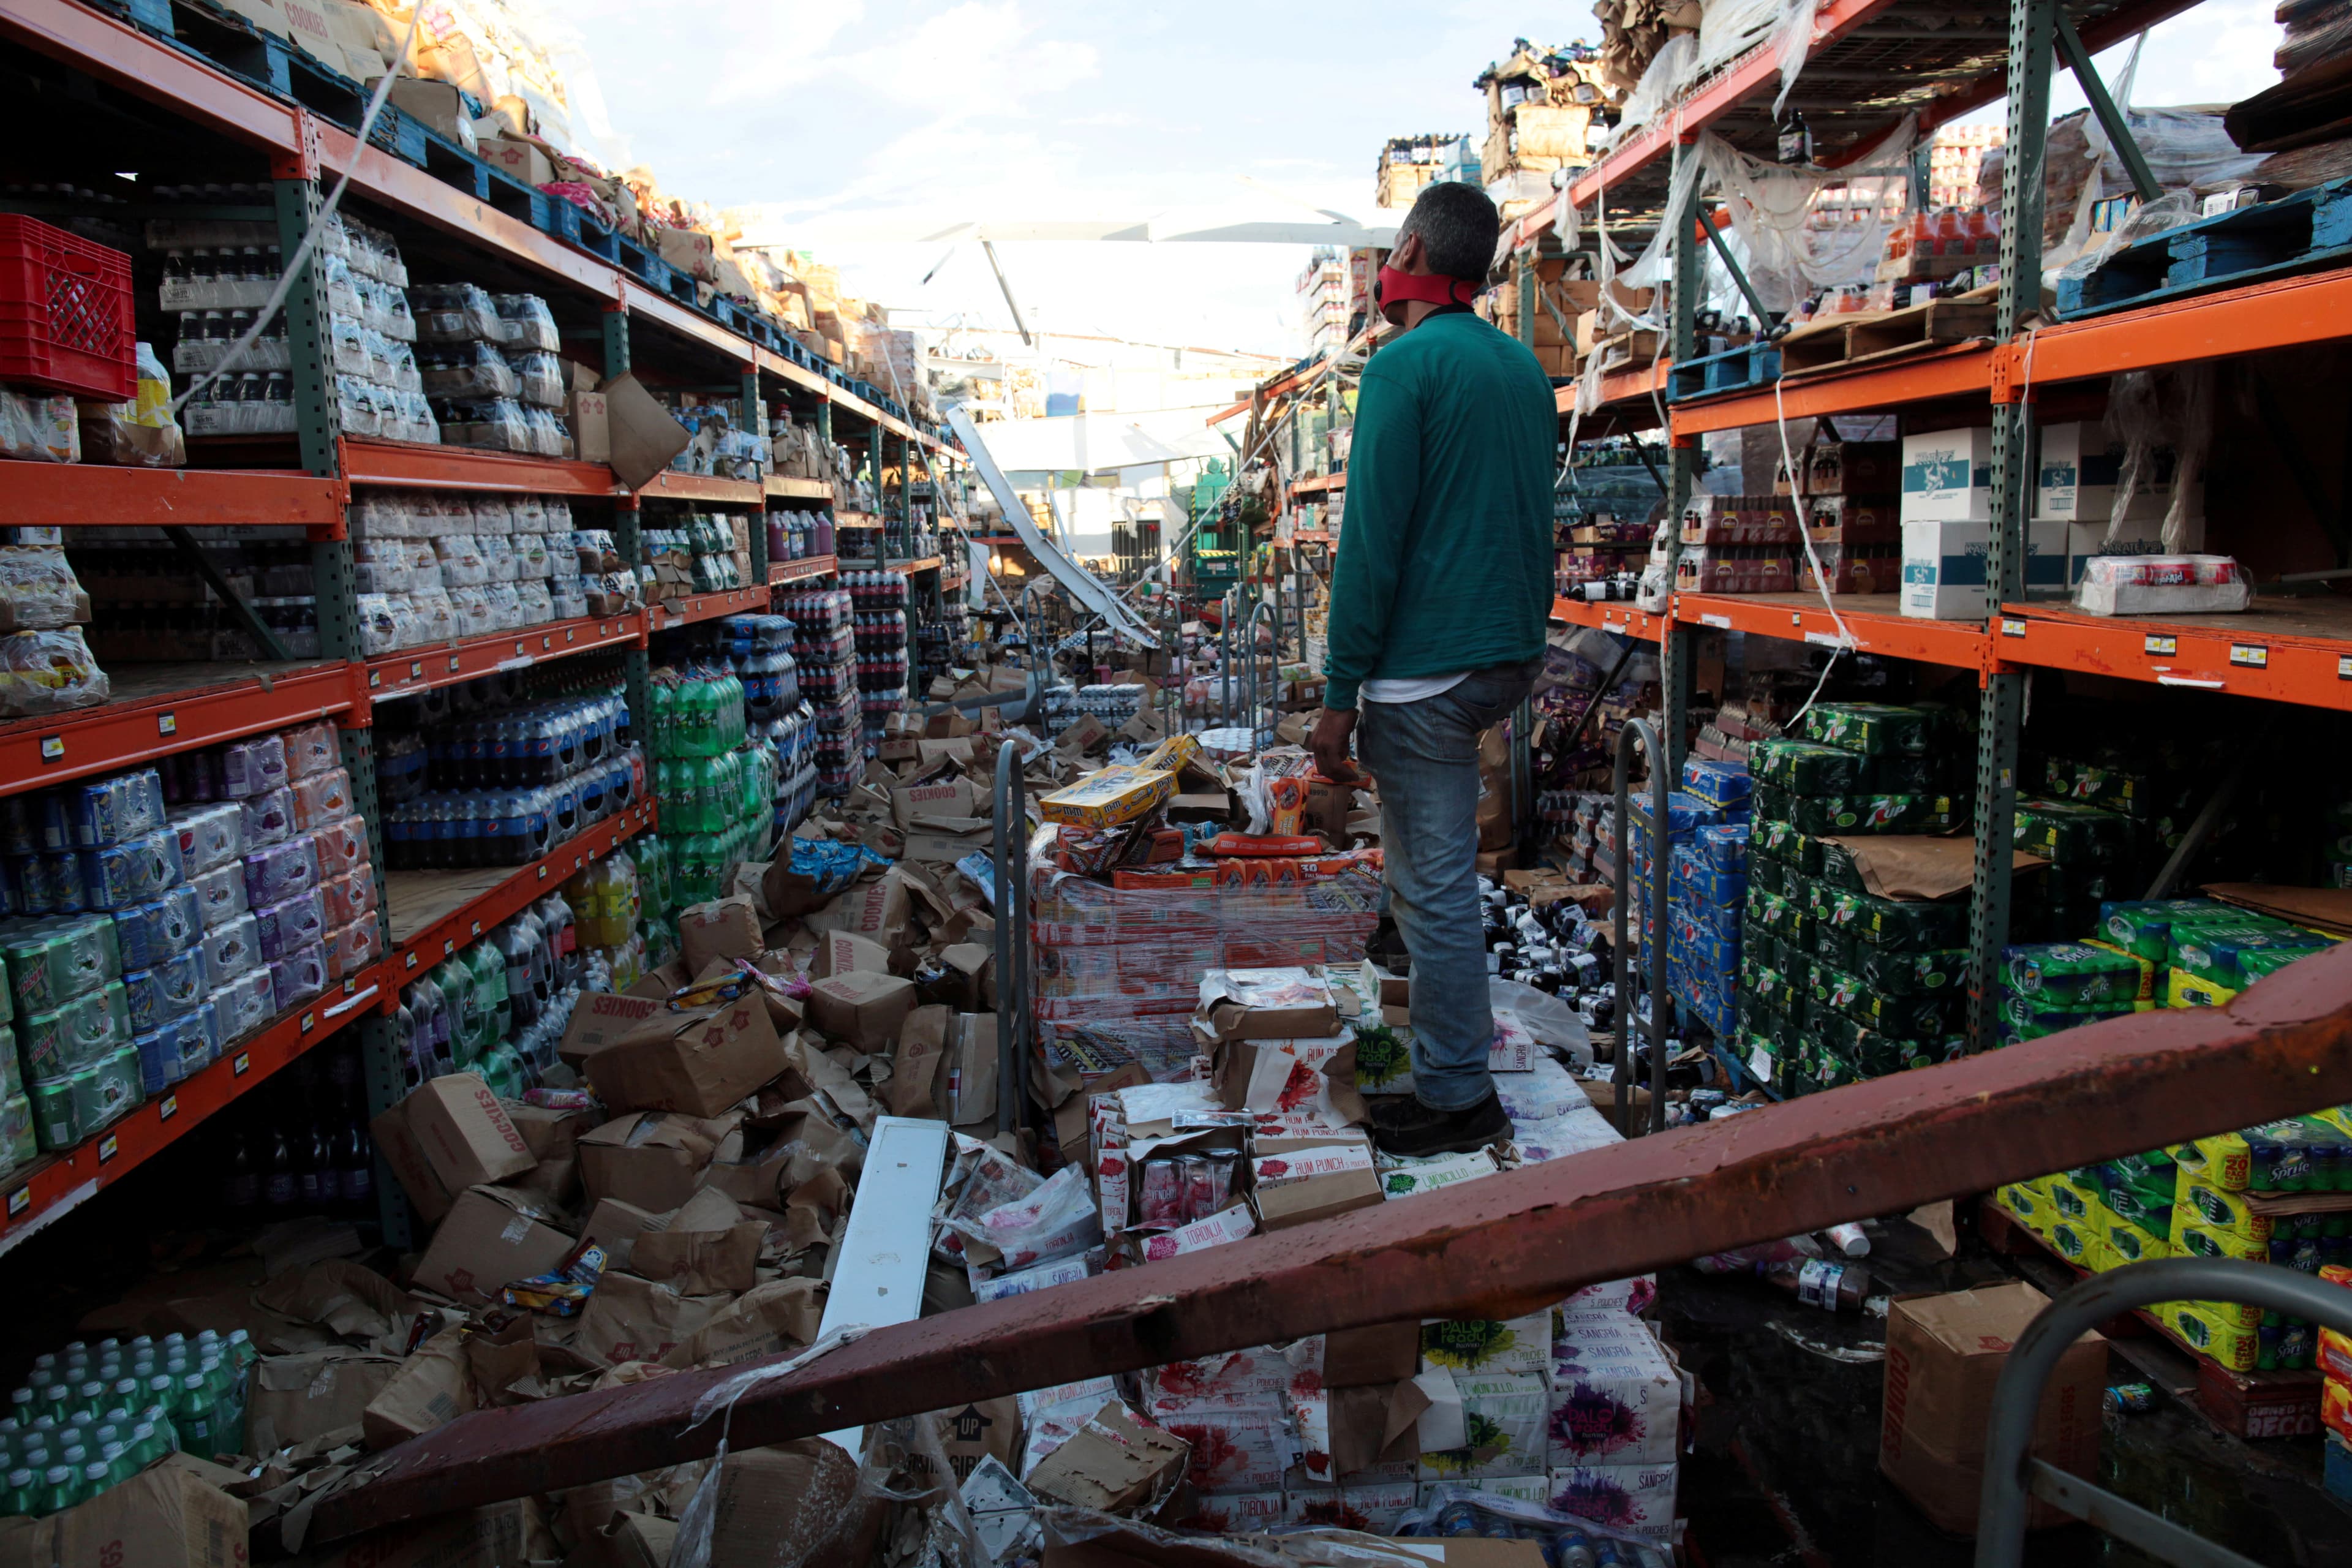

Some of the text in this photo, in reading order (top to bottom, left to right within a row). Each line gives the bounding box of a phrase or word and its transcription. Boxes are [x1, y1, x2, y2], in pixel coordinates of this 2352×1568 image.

[284, 2, 328, 39] COOKIES
[910, 786, 956, 802] COOKIES
[1300, 864, 1317, 873] 30
[861, 884, 887, 932] COOKIES
[592, 996, 657, 1020] COOKIES
[1308, 1048, 1324, 1062] RUM
[1357, 1052, 1392, 1066] eady
[1292, 1127, 1310, 1136] RUM
[1313, 1128, 1339, 1136] PUNCH
[1295, 1161, 1315, 1176] RUM
[1316, 1156, 1346, 1172] PUNCH
[2225, 1159, 2248, 1170] 20
[1422, 1167, 1469, 1187] LIMONCILLO
[2269, 1162, 2311, 1183] Sprite
[1186, 1221, 1224, 1246] TORONJA
[1045, 1232, 1074, 1251] TORONJA
[1150, 1238, 1172, 1251] PALO
[1052, 1266, 1084, 1285] SANGRÍA
[1597, 1297, 1623, 1306] POUCHES
[1441, 1320, 1486, 1333] PALO
[1578, 1327, 1622, 1339] SANGRÍA
[1441, 1332, 1487, 1347] ready
[2236, 1340, 2257, 1351] 20
[1512, 1349, 1547, 1362] 5 POUCHES
[1588, 1344, 1633, 1358] SANGRÍA
[1597, 1365, 1643, 1378] SANGRÍA
[1256, 1378, 1285, 1387] POUCHES
[1058, 1380, 1087, 1401] PUNCH
[1882, 1348, 1912, 1460] COOKIES
[2060, 1384, 2076, 1422] EGGS
[1568, 1410, 1613, 1423] PALO
[961, 1418, 979, 1435] UP
[1572, 1422, 1613, 1436] ready
[2247, 1415, 2316, 1437] RECO
[1244, 1471, 1281, 1485] 5 POUCHES
[1238, 1500, 1279, 1516] TORONJA
[1642, 1525, 1670, 1535] POUCHES
